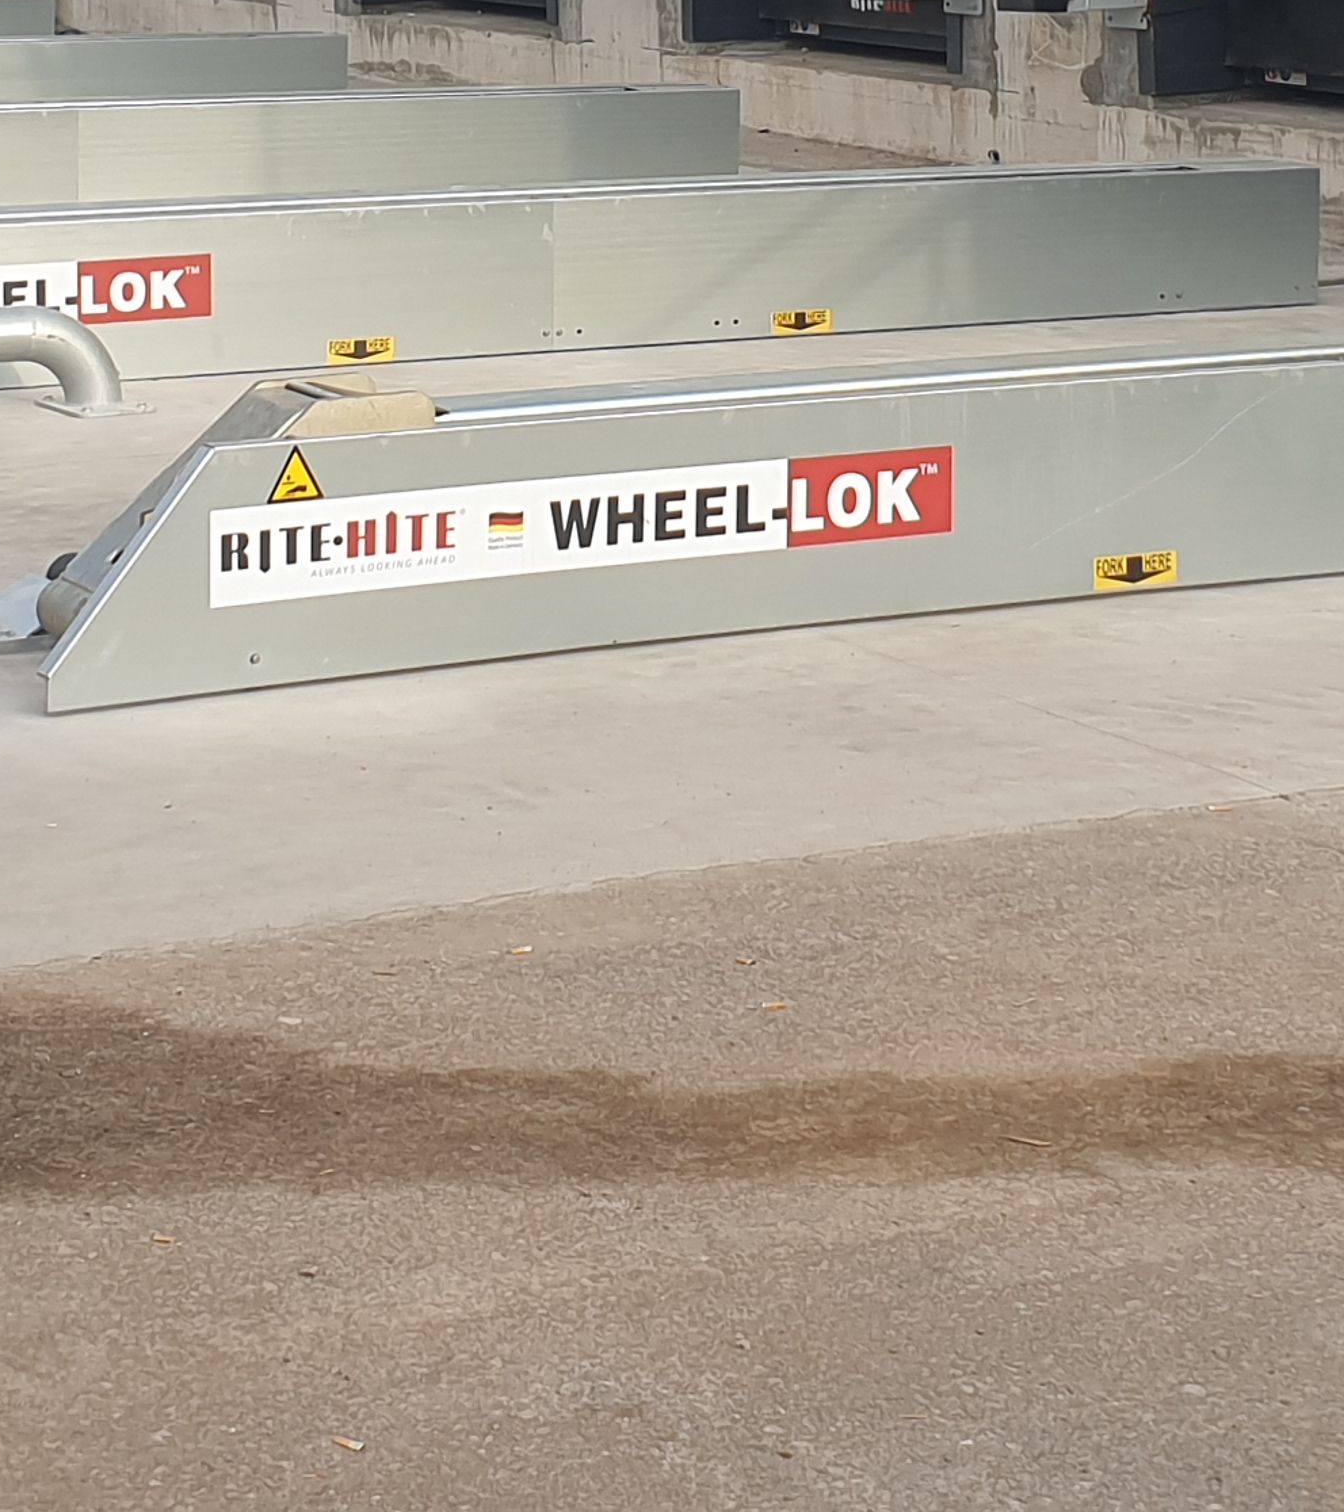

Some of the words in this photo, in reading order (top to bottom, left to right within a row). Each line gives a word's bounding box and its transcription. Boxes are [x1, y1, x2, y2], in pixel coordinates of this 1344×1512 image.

[310, 564, 356, 578] ALWAYS
[360, 558, 413, 573] LOOKING
[417, 553, 456, 567] AHEAD
[1096, 557, 1124, 577] FORK
[1144, 551, 1173, 571] HERE
